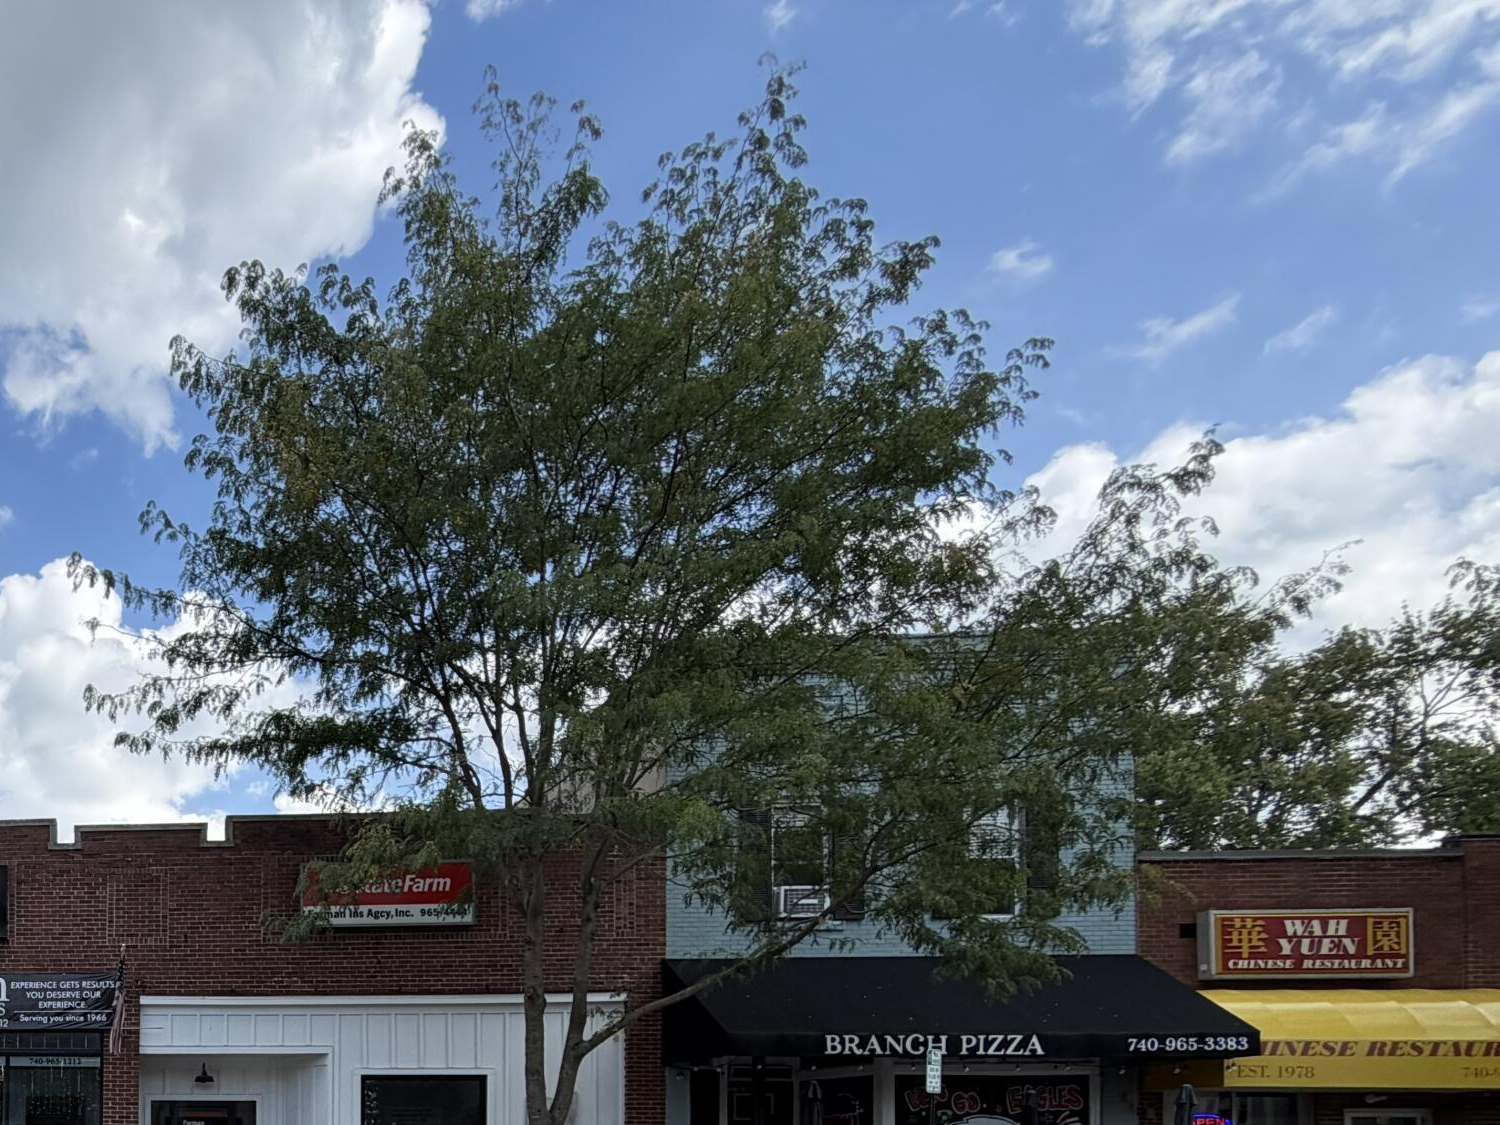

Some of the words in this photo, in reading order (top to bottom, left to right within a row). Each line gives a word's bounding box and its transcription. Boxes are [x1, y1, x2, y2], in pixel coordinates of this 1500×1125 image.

[395, 908, 415, 918] Inc.
[1283, 919, 1349, 936] WAH
[1277, 938, 1360, 955] YUEN
[1228, 959, 1295, 969] CHINESE
[1302, 958, 1406, 969] RESTAURANT
[10, 981, 57, 989] EXPERIENCE
[59, 981, 80, 989] GETS
[19, 1014, 48, 1023] Serving
[50, 1015, 64, 1023] you
[65, 1014, 85, 1022] since
[86, 1013, 107, 1022] 1966
[825, 1034, 948, 1055] BRANCH
[960, 1034, 1045, 1055] PIZZA
[1127, 1037, 1249, 1051] 740-965-3383
[1237, 1065, 1270, 1078] EST.
[1278, 1065, 1316, 1078] 1978
